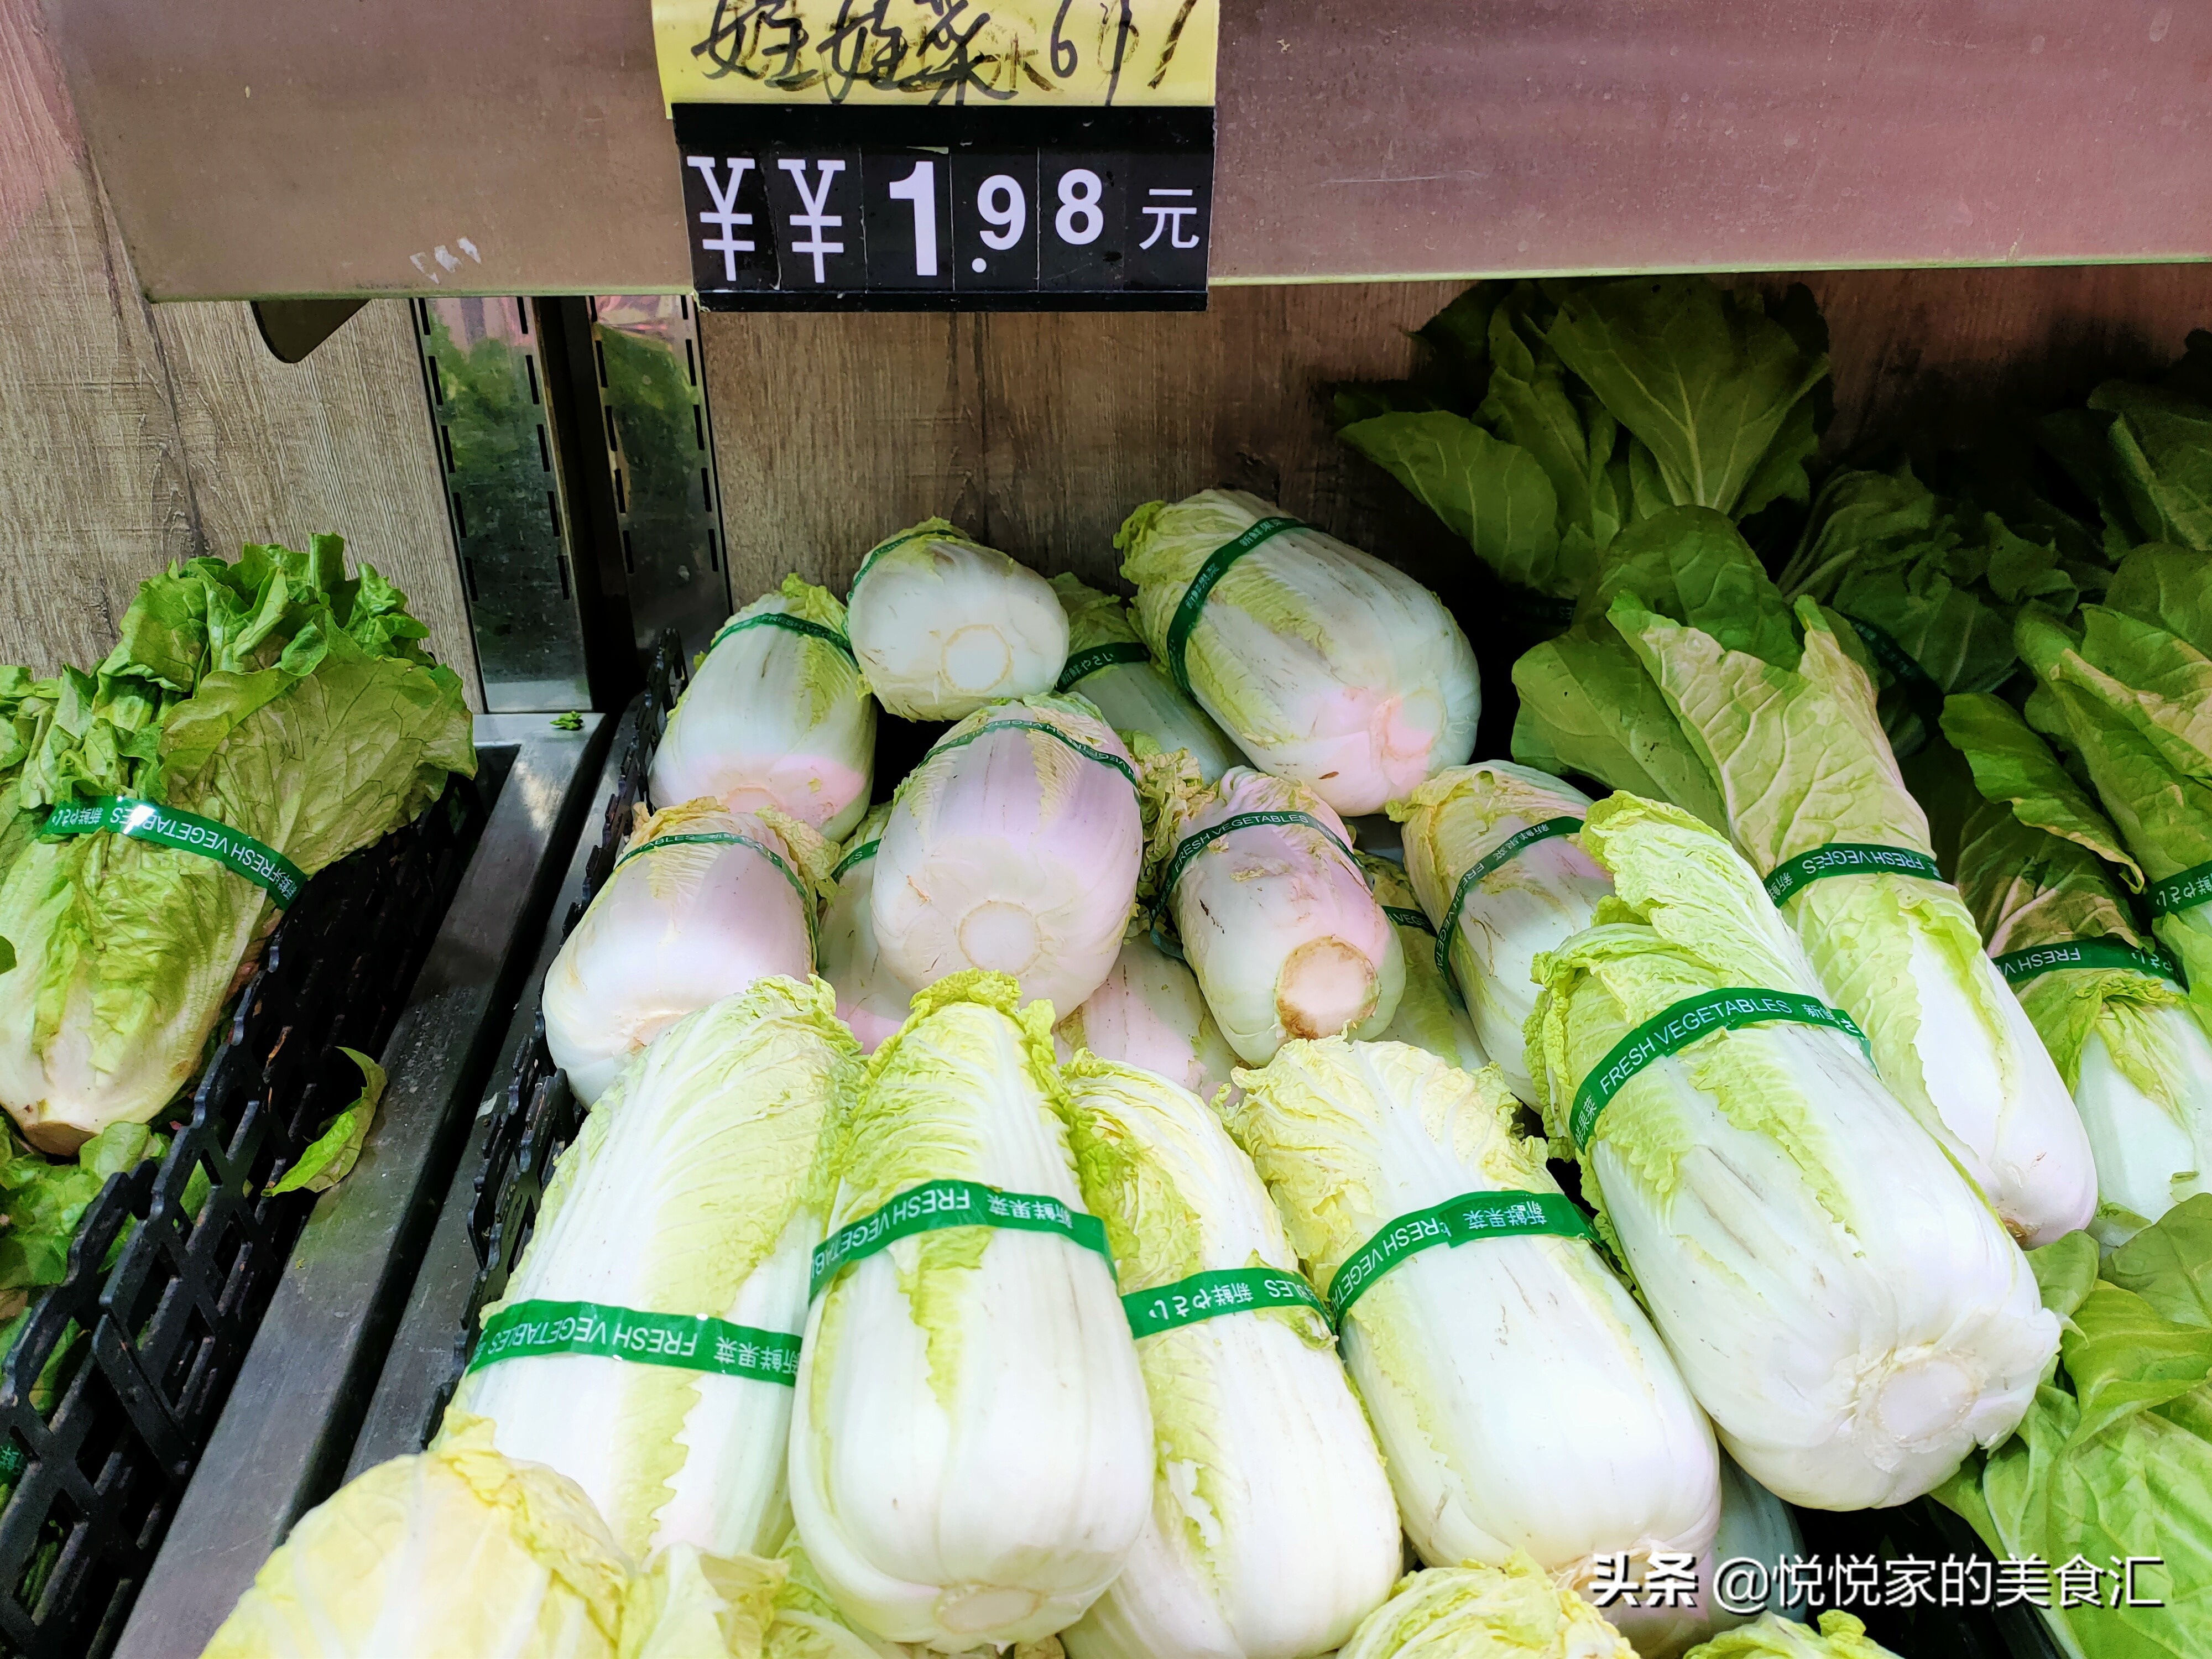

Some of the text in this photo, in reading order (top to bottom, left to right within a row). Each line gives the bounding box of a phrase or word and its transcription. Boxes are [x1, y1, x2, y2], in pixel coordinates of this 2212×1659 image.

[110, 806, 228, 854] VEGETABES
[1175, 814, 1310, 873] FRESH VEGETABLES
[231, 846, 283, 884] FRESH
[1874, 851, 1925, 870] FRESH
[1451, 862, 1485, 909] FRESH
[2156, 872, 2212, 907] 鲜やさい
[2018, 947, 2082, 972] FRESH
[1599, 1036, 1656, 1095] FRESH
[1653, 998, 1793, 1046] VEGETABLES
[893, 1188, 971, 1225] FRESH
[487, 1317, 608, 1355] VEGETABLES
[613, 1322, 698, 1357] FRESH
